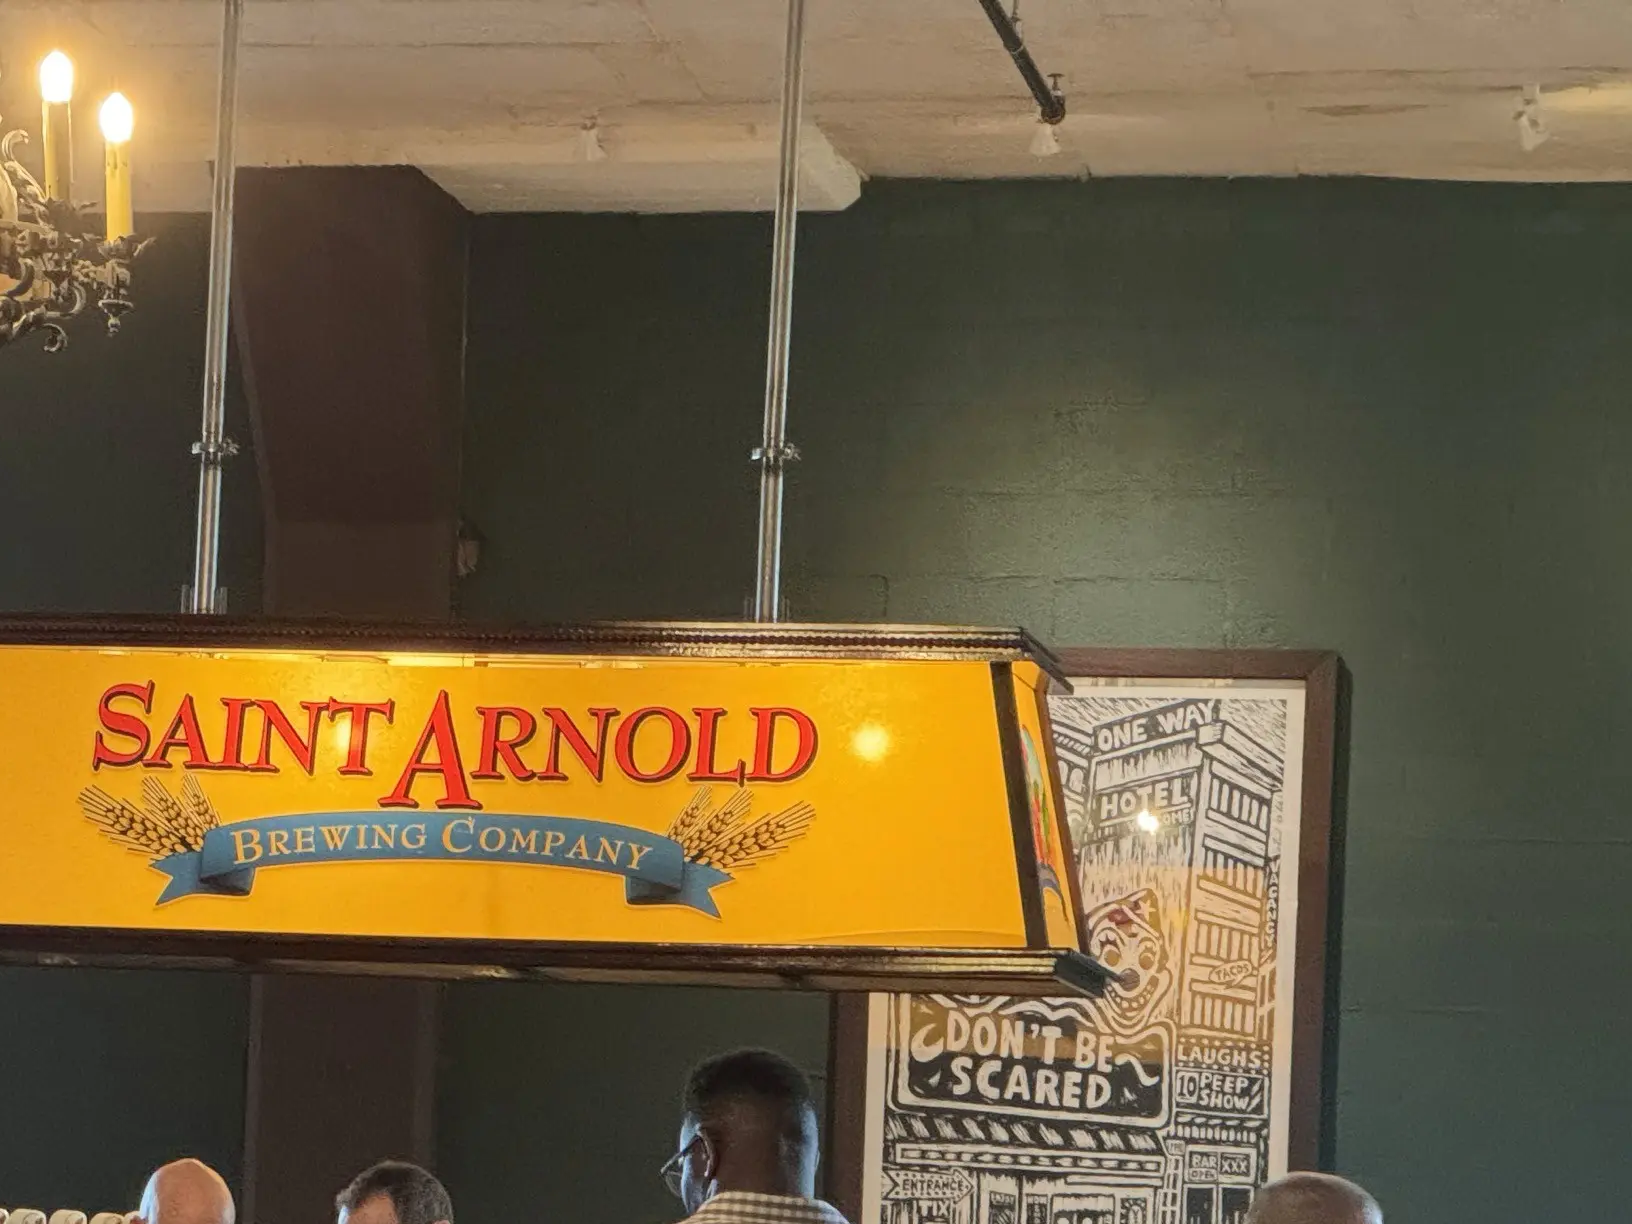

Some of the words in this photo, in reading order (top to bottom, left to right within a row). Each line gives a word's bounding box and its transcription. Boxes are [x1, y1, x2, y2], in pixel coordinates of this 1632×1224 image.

[1097, 717, 1148, 752] ONE
[1155, 700, 1216, 734] WAY
[91, 679, 393, 775] SAINT
[378, 688, 819, 809] ARNOLD
[229, 822, 428, 865] BREWING
[441, 815, 654, 871] COMPANY
[1266, 859, 1280, 948] VACANCY
[1215, 963, 1250, 981] TACOS
[946, 1009, 1064, 1065] DON'T
[1074, 1030, 1116, 1074] BE
[1177, 1044, 1263, 1069] LAUGHS
[950, 1056, 1112, 1109] SCARED
[1199, 1073, 1249, 1094] PEEP
[1198, 1089, 1250, 1110] SHOW
[1191, 1155, 1218, 1168] BAR
[1222, 1159, 1248, 1174] XXX
[902, 1178, 964, 1192] ENTRANCE
[918, 1201, 949, 1217] TIX
